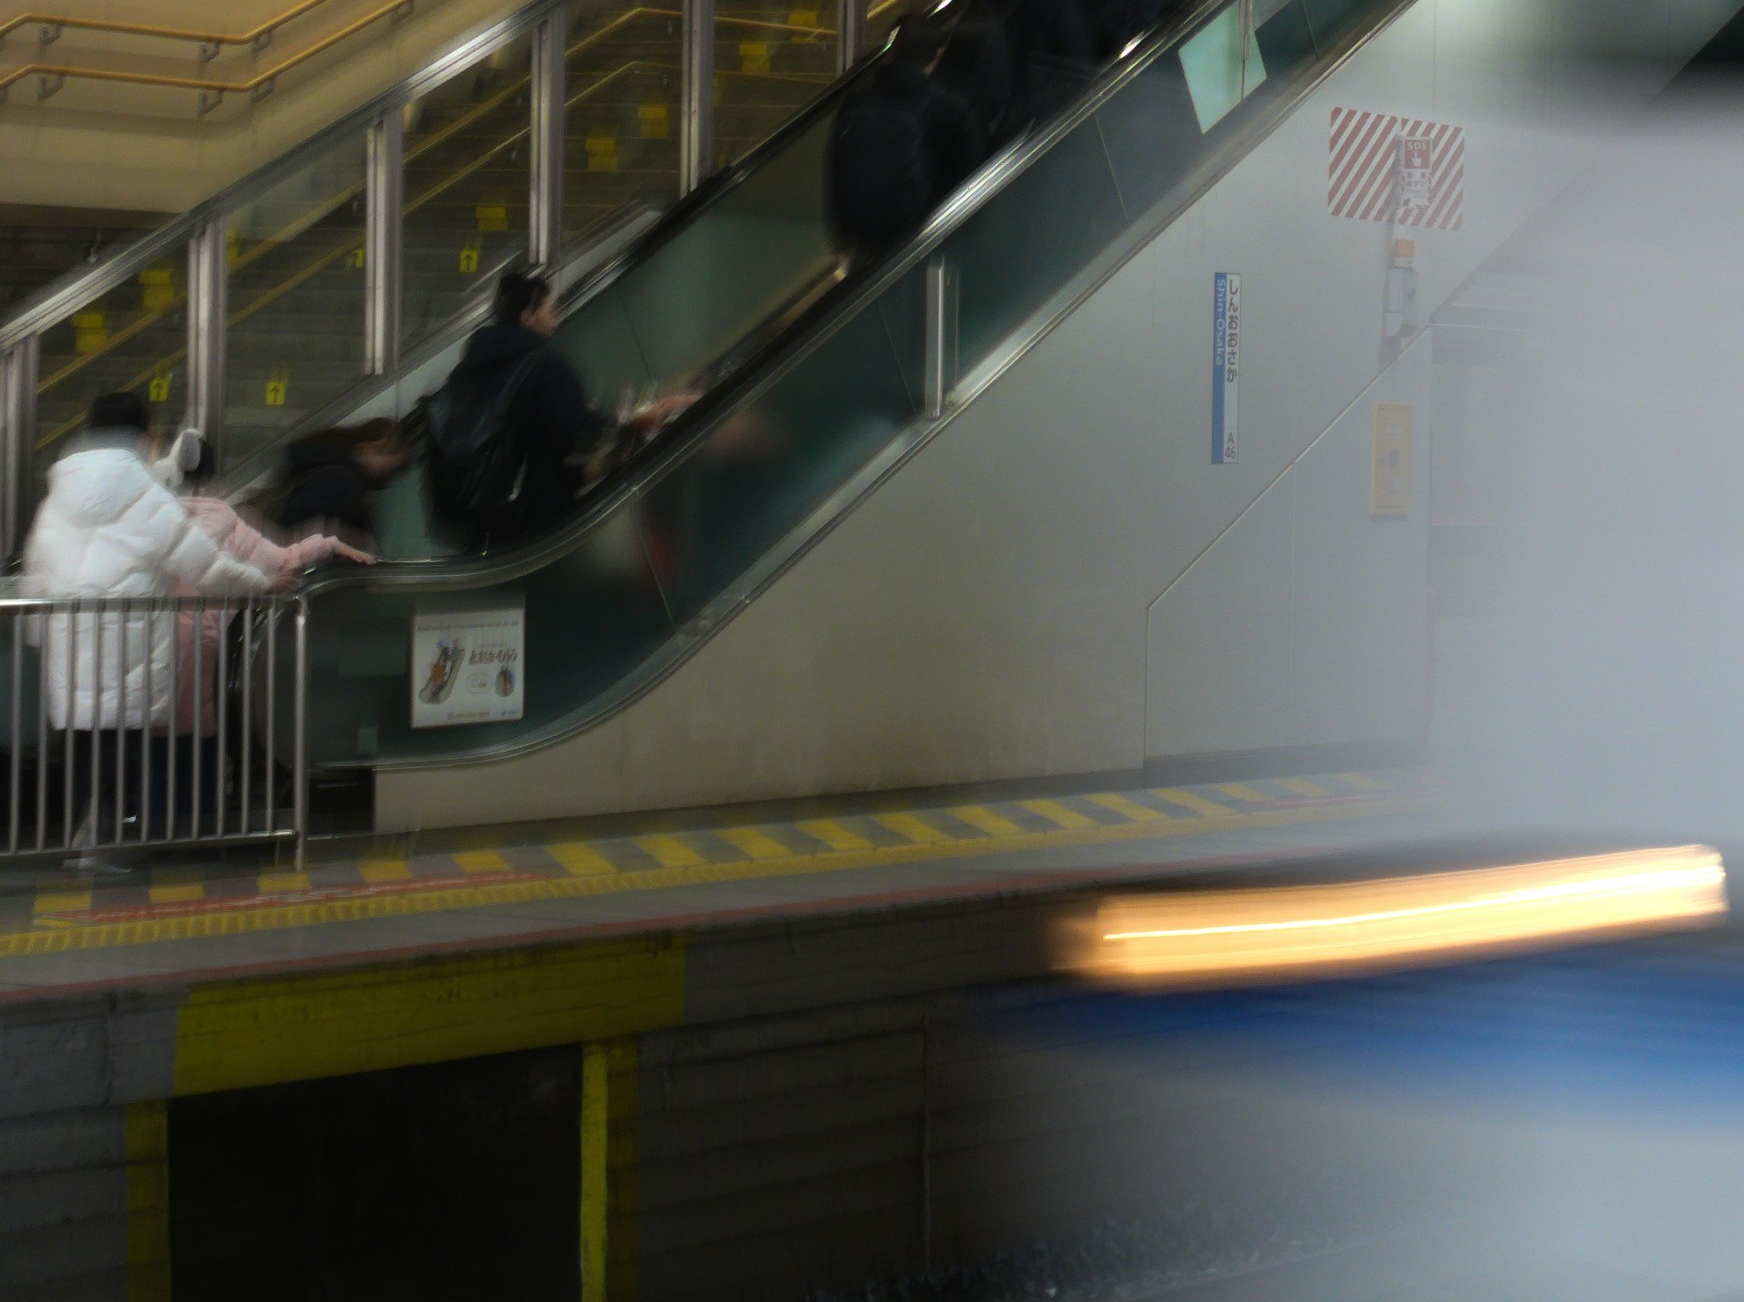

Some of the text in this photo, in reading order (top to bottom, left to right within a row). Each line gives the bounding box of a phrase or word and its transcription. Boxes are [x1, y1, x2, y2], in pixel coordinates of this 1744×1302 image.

[1215, 279, 1226, 366] Shin-Osaka
[1226, 279, 1239, 384] しんおおさか
